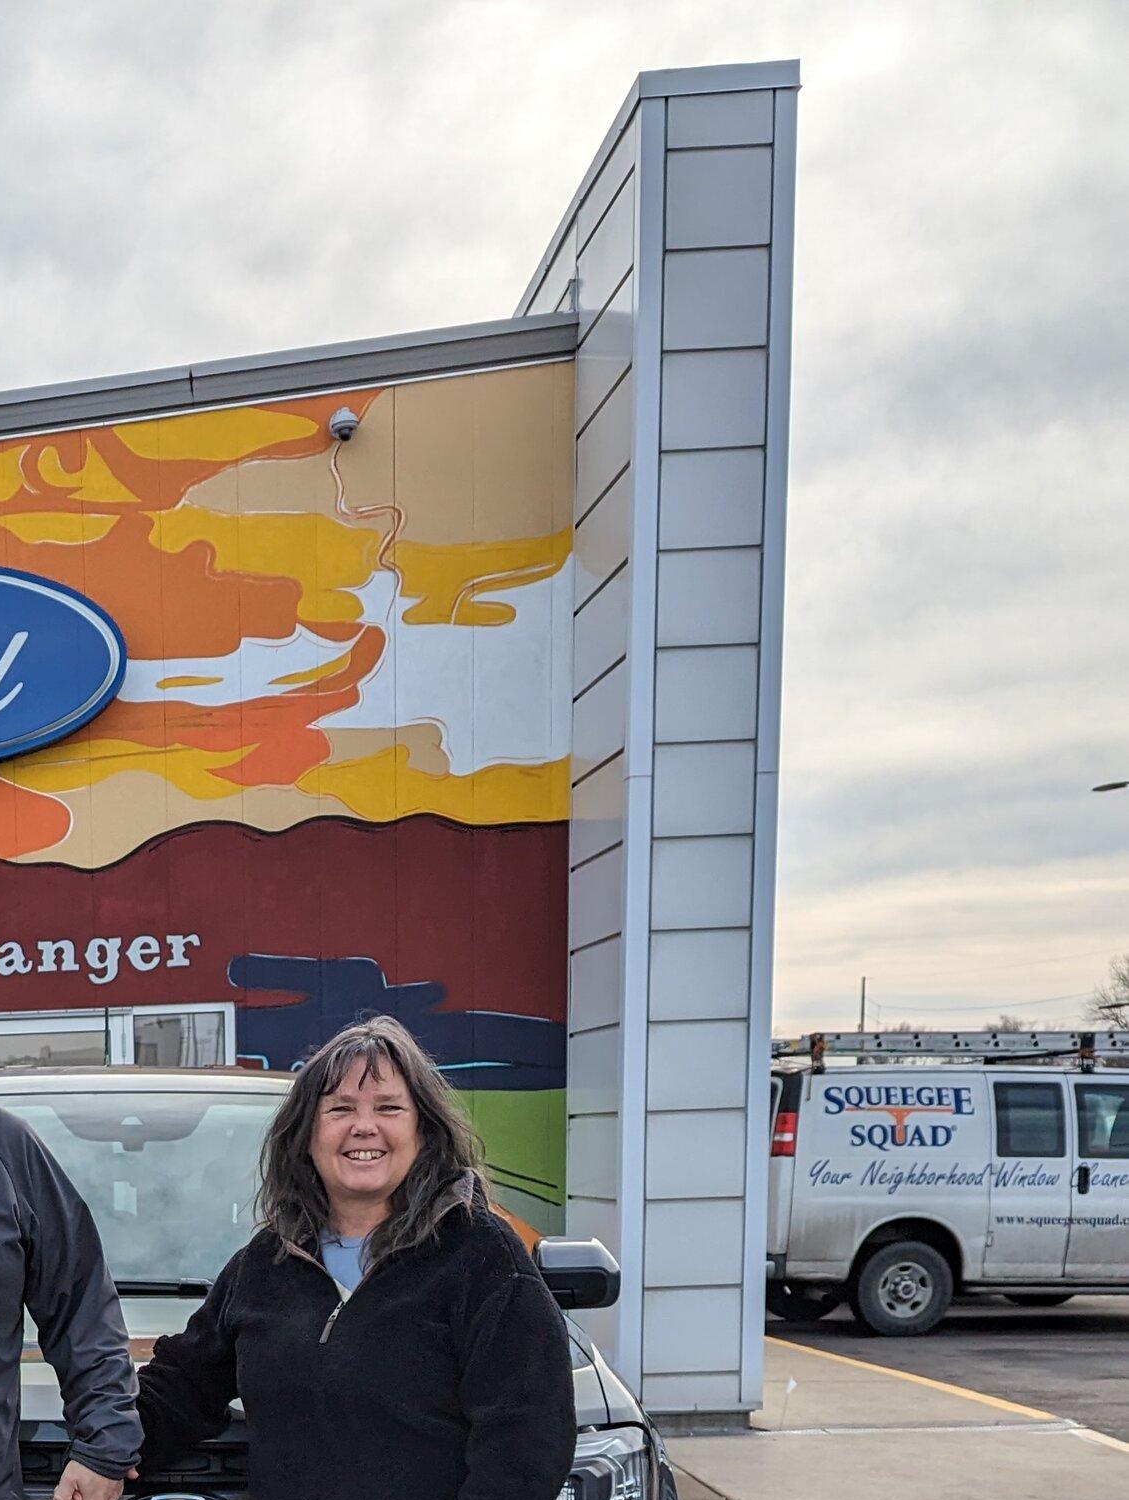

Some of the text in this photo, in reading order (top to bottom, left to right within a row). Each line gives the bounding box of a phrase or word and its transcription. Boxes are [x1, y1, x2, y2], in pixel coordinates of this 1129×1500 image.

[823, 1086, 975, 1115] SQUEEGEE
[850, 1124, 953, 1151] SQUAD
[809, 1159, 852, 1187] Your
[860, 1160, 992, 1195] Neighborhood
[994, 1161, 1061, 1188] Window
